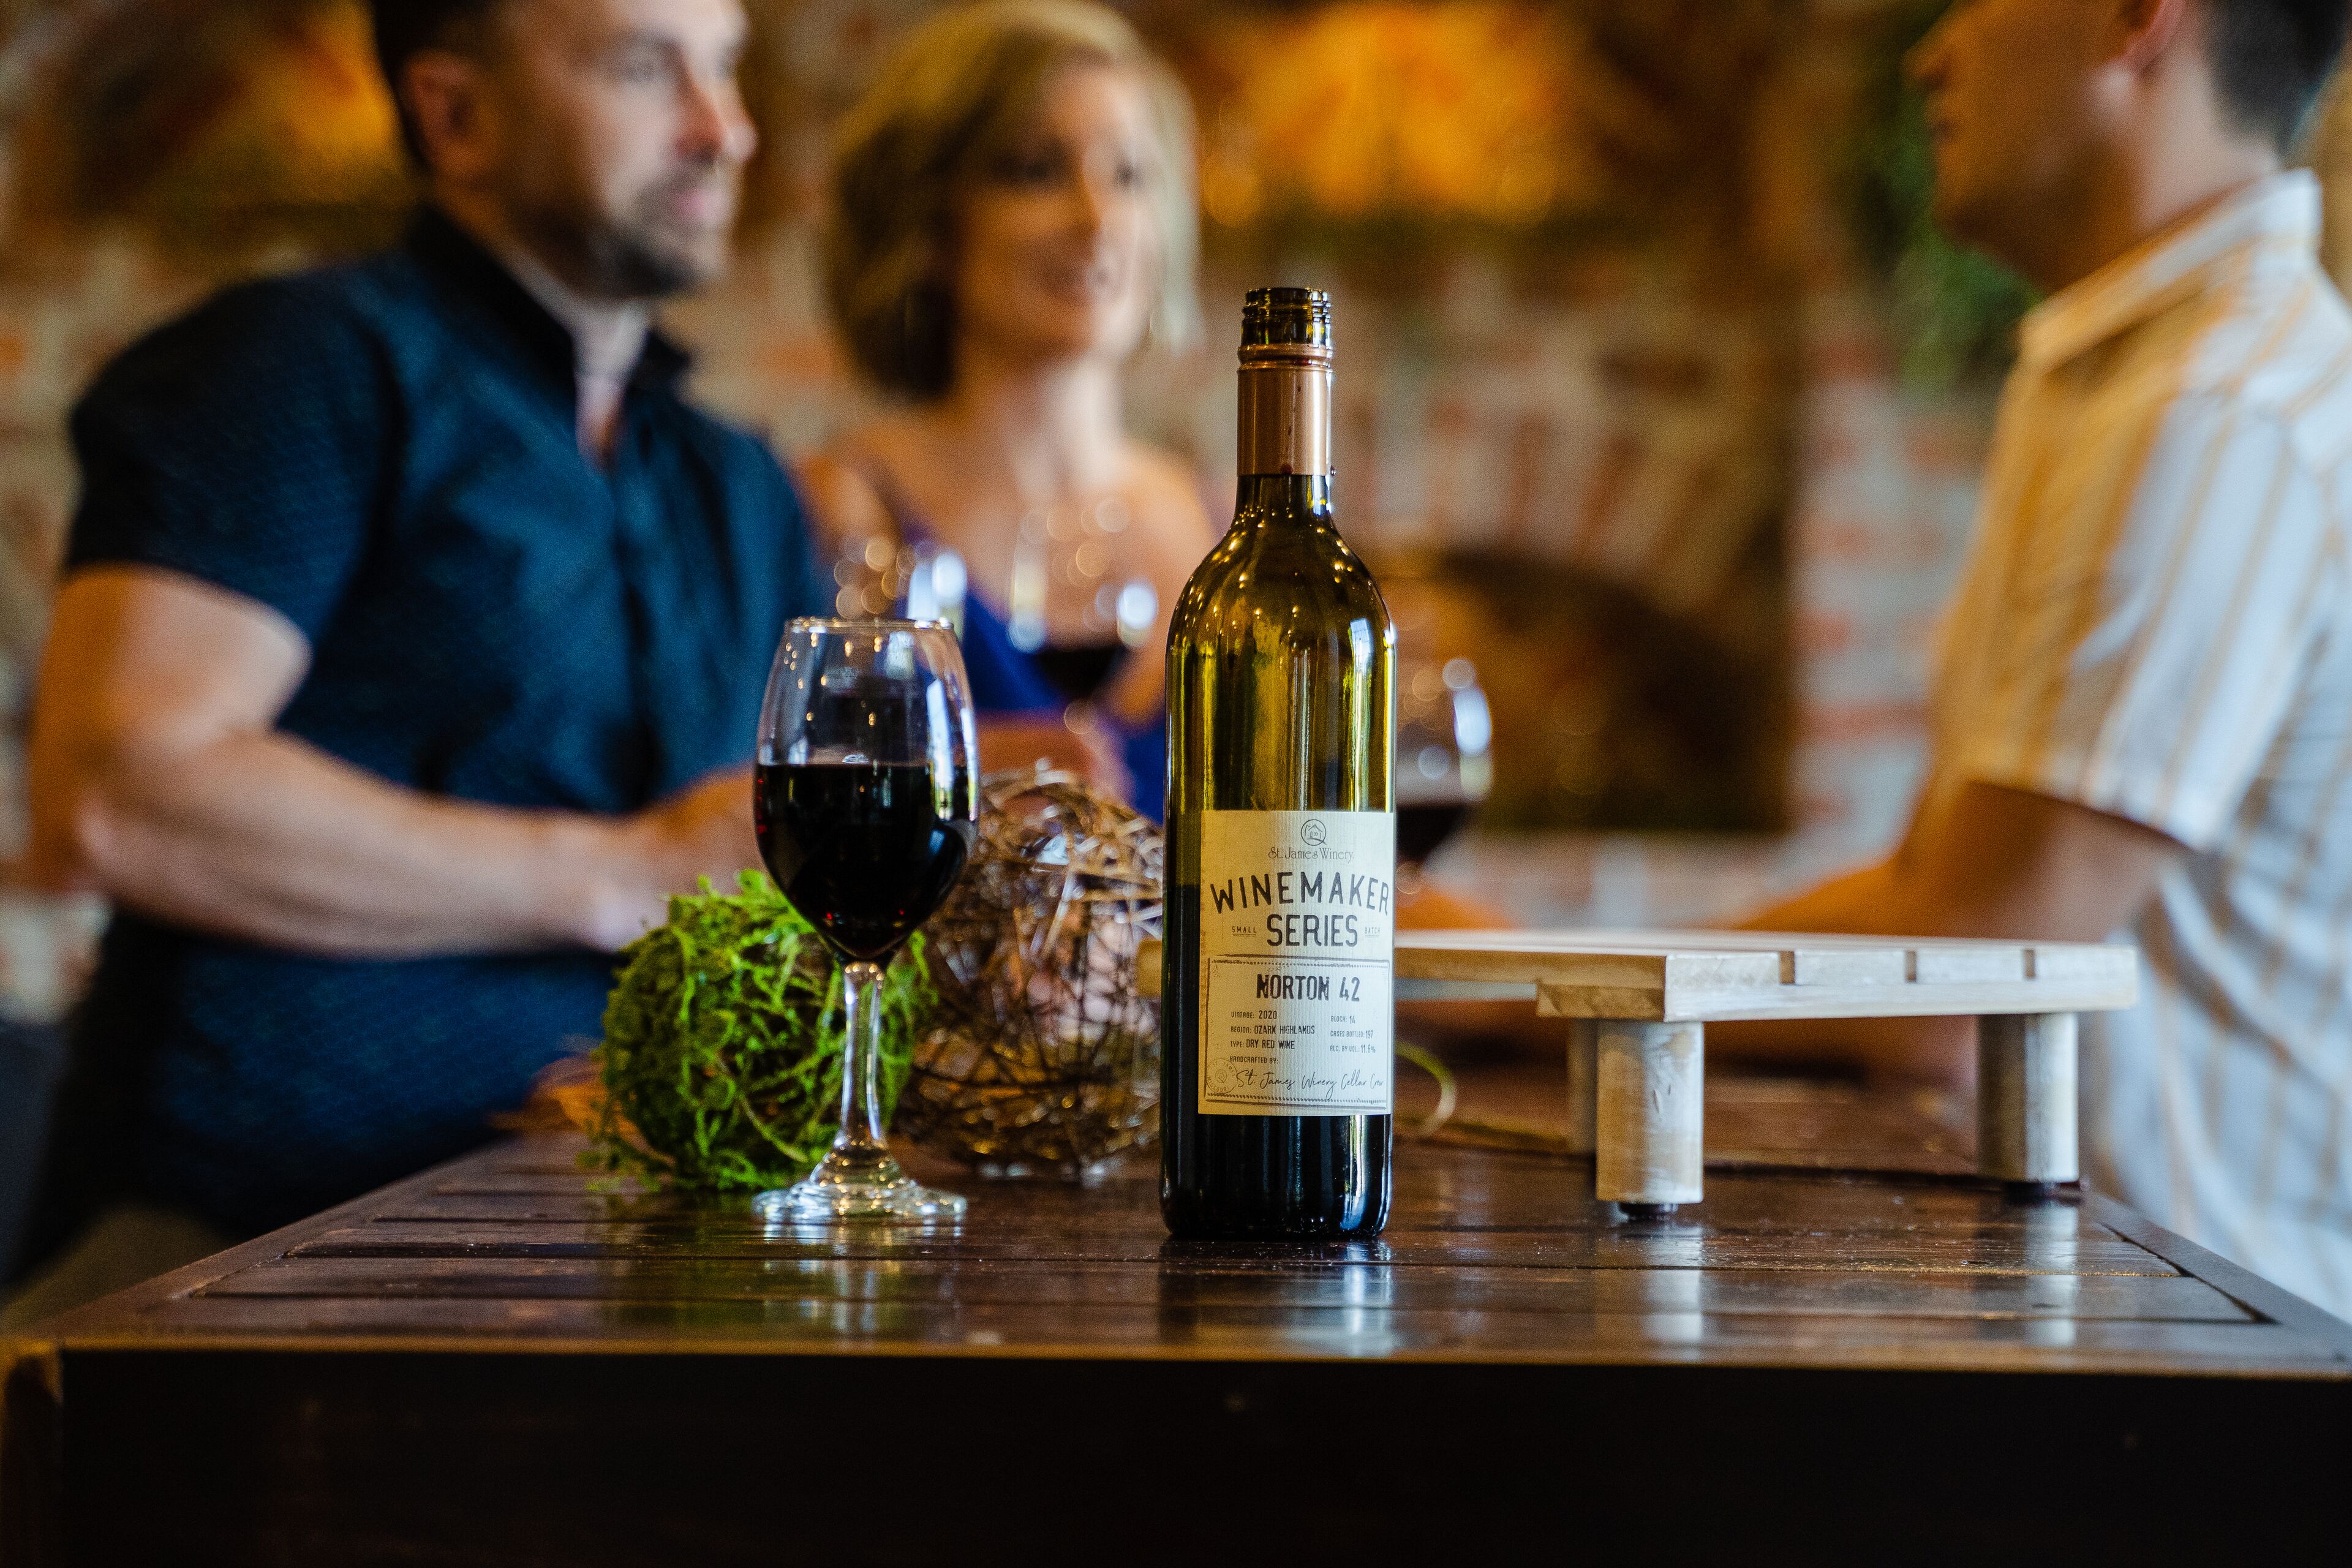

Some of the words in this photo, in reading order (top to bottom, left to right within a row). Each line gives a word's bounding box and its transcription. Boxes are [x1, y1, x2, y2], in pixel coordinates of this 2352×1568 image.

[1284, 846, 1318, 859] James
[1210, 871, 1389, 916] WINEMAKER
[1266, 914, 1358, 947] SERIES
[1256, 973, 1330, 1001] NORTON
[1339, 976, 1360, 1002] 42
[1258, 1010, 1277, 1019] 2020
[1349, 1016, 1355, 1024] 14
[1254, 1025, 1276, 1034] OZARK
[1280, 1025, 1315, 1035] HIGHLANDS
[1246, 1039, 1259, 1048] DRY
[1262, 1039, 1275, 1049] RED
[1278, 1040, 1295, 1049] WINE
[1236, 1069, 1256, 1088] St.
[1259, 1072, 1296, 1090] James
[1301, 1071, 1338, 1100] Winery
[1340, 1069, 1366, 1090] Cellar
[1370, 1073, 1384, 1089] Crew
